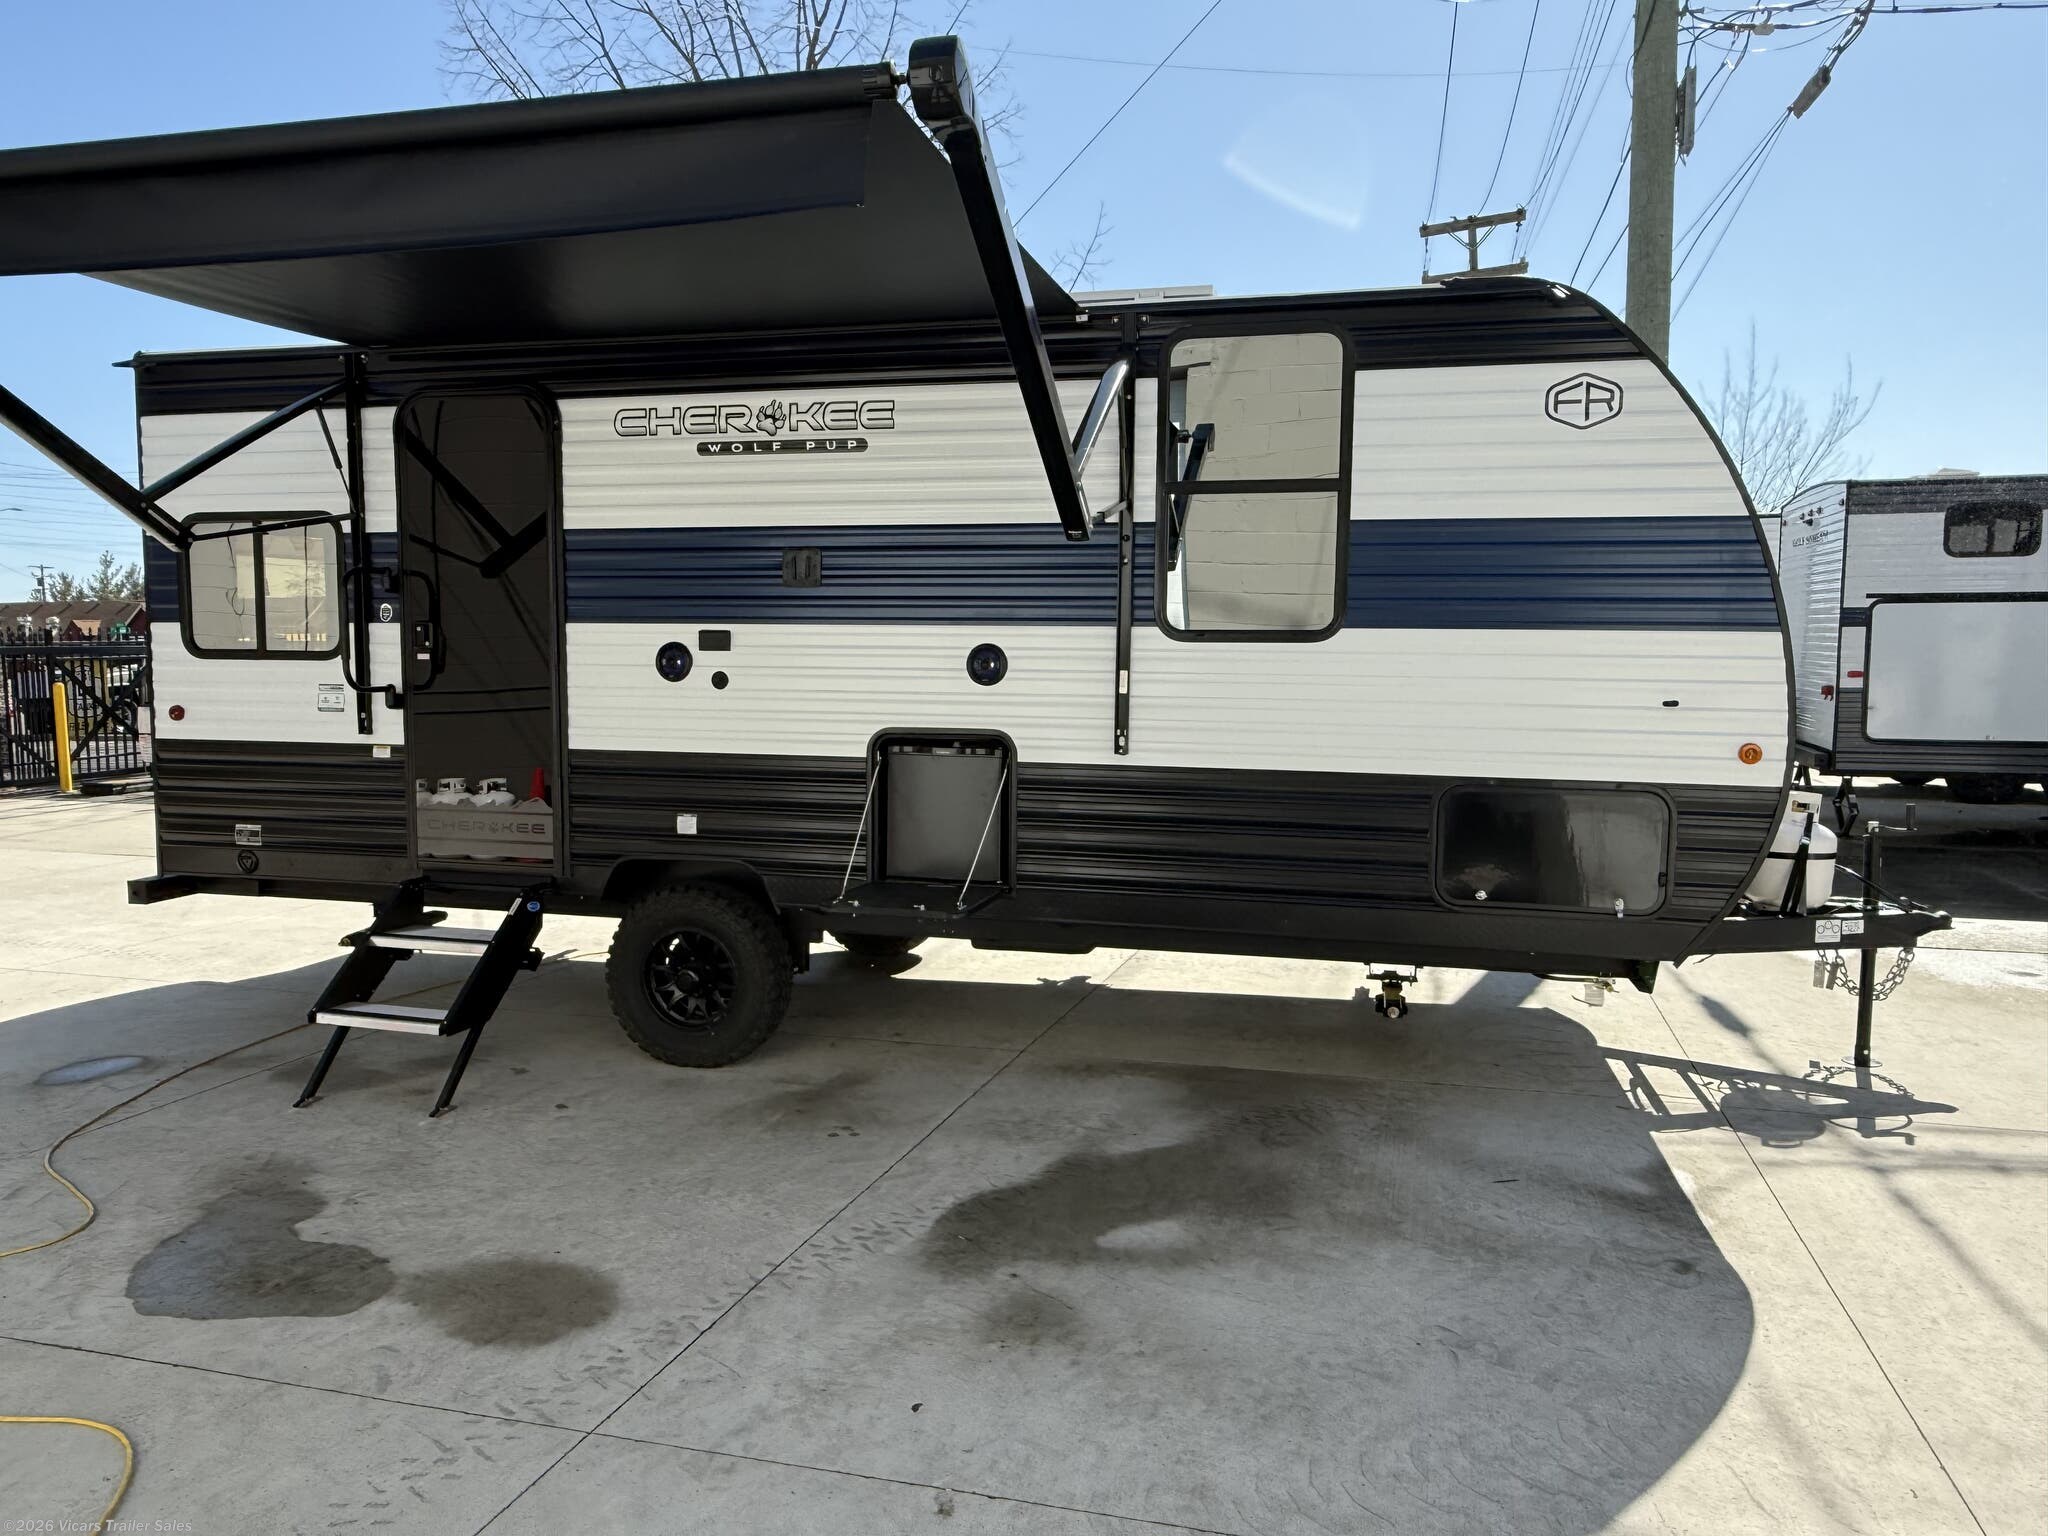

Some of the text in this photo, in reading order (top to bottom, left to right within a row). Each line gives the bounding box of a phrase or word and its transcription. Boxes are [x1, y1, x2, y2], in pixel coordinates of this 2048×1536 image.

[1553, 381, 1615, 421] FR
[707, 440, 857, 454] WOLF PUP
